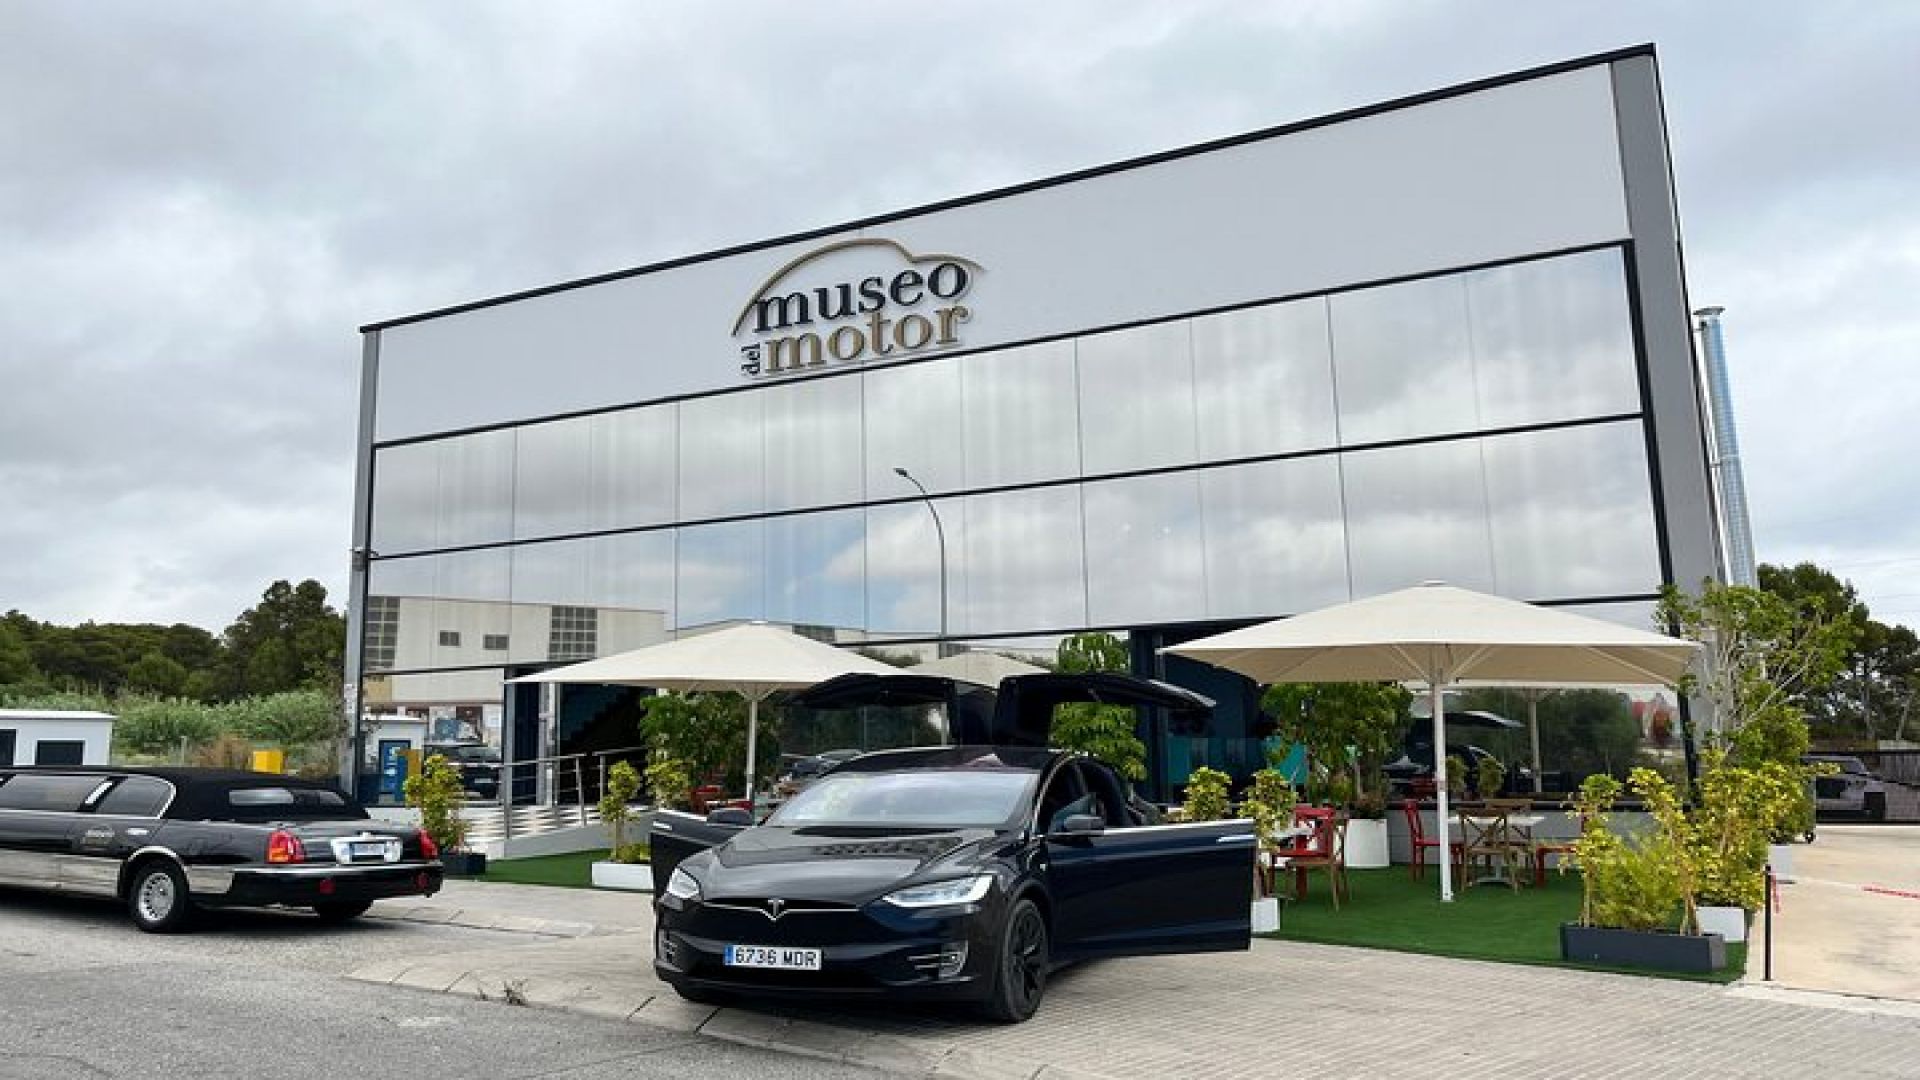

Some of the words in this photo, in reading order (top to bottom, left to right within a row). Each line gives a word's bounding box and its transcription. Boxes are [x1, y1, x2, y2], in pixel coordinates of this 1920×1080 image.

[753, 262, 969, 333] museo
[740, 342, 761, 375] del
[765, 305, 970, 373] motor
[783, 951, 817, 967] MDR
